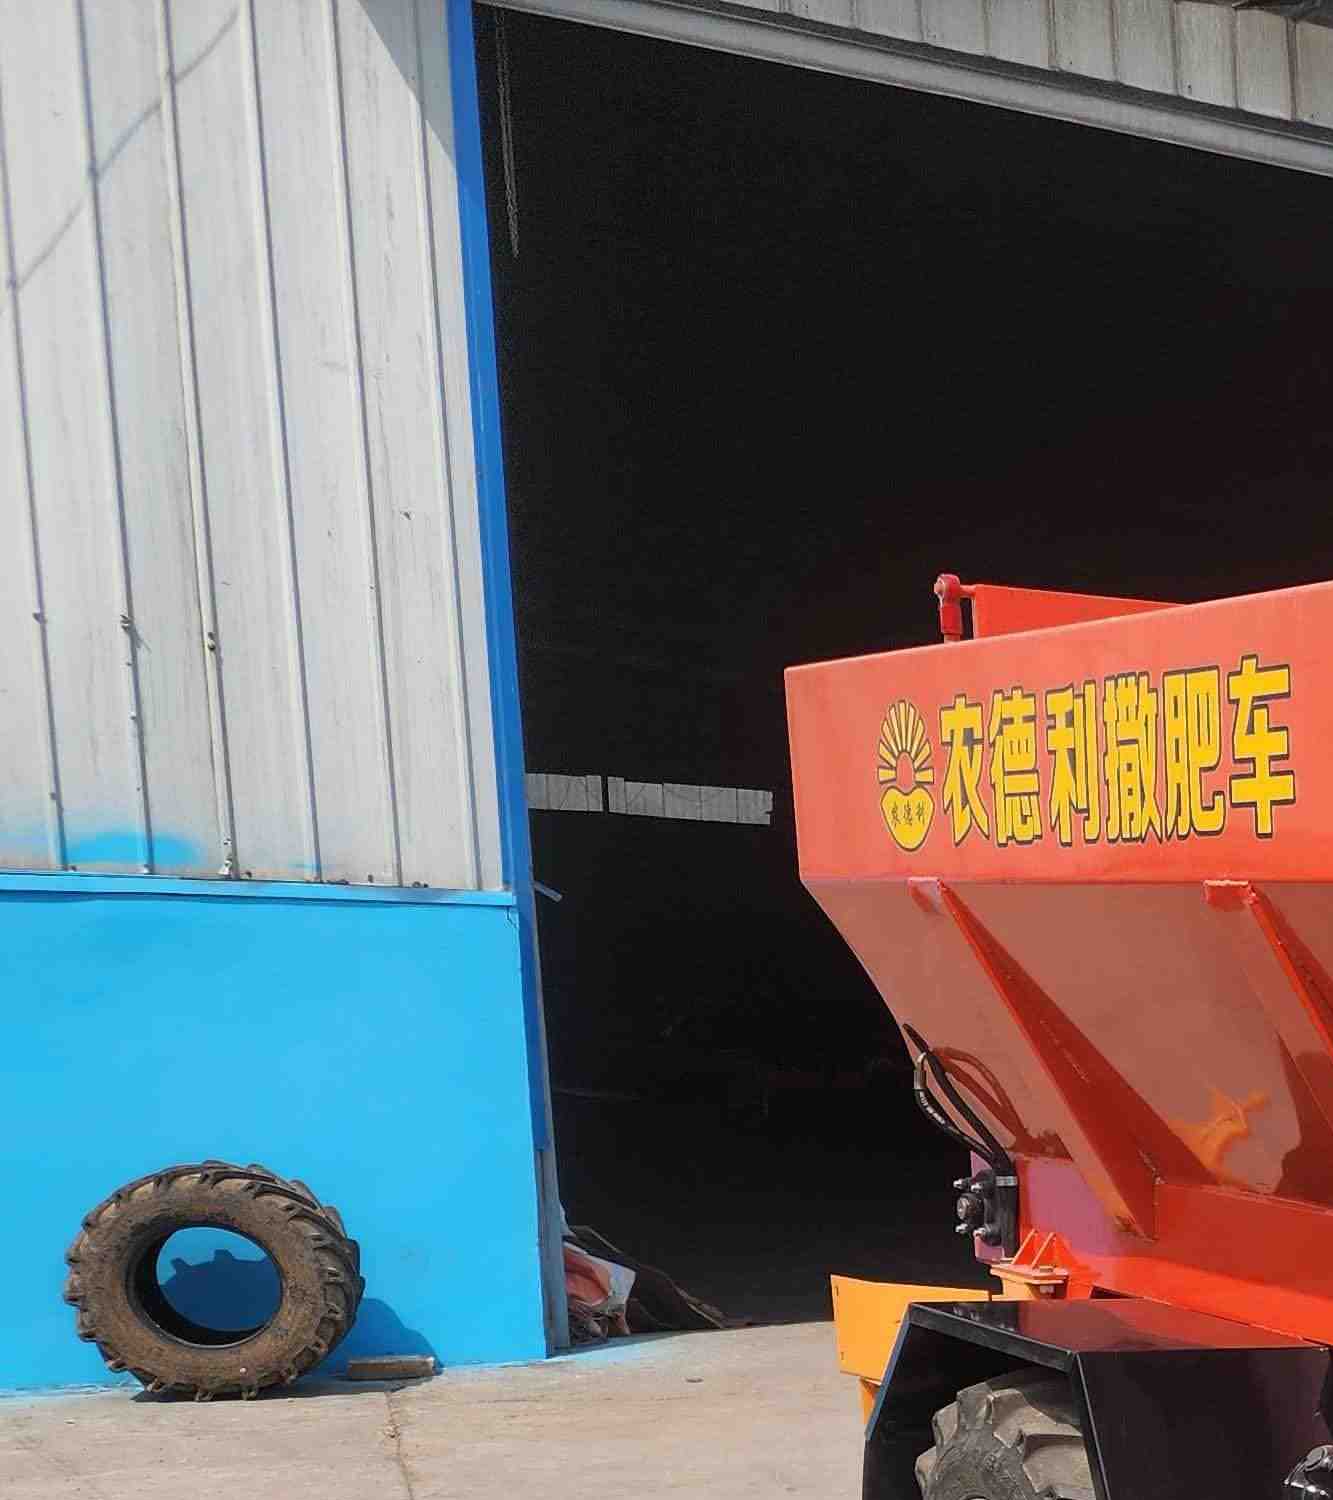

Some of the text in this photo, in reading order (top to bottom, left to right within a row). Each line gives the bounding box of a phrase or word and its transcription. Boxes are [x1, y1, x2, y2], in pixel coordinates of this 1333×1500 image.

[940, 654, 1297, 846] 农德利撒肥车
